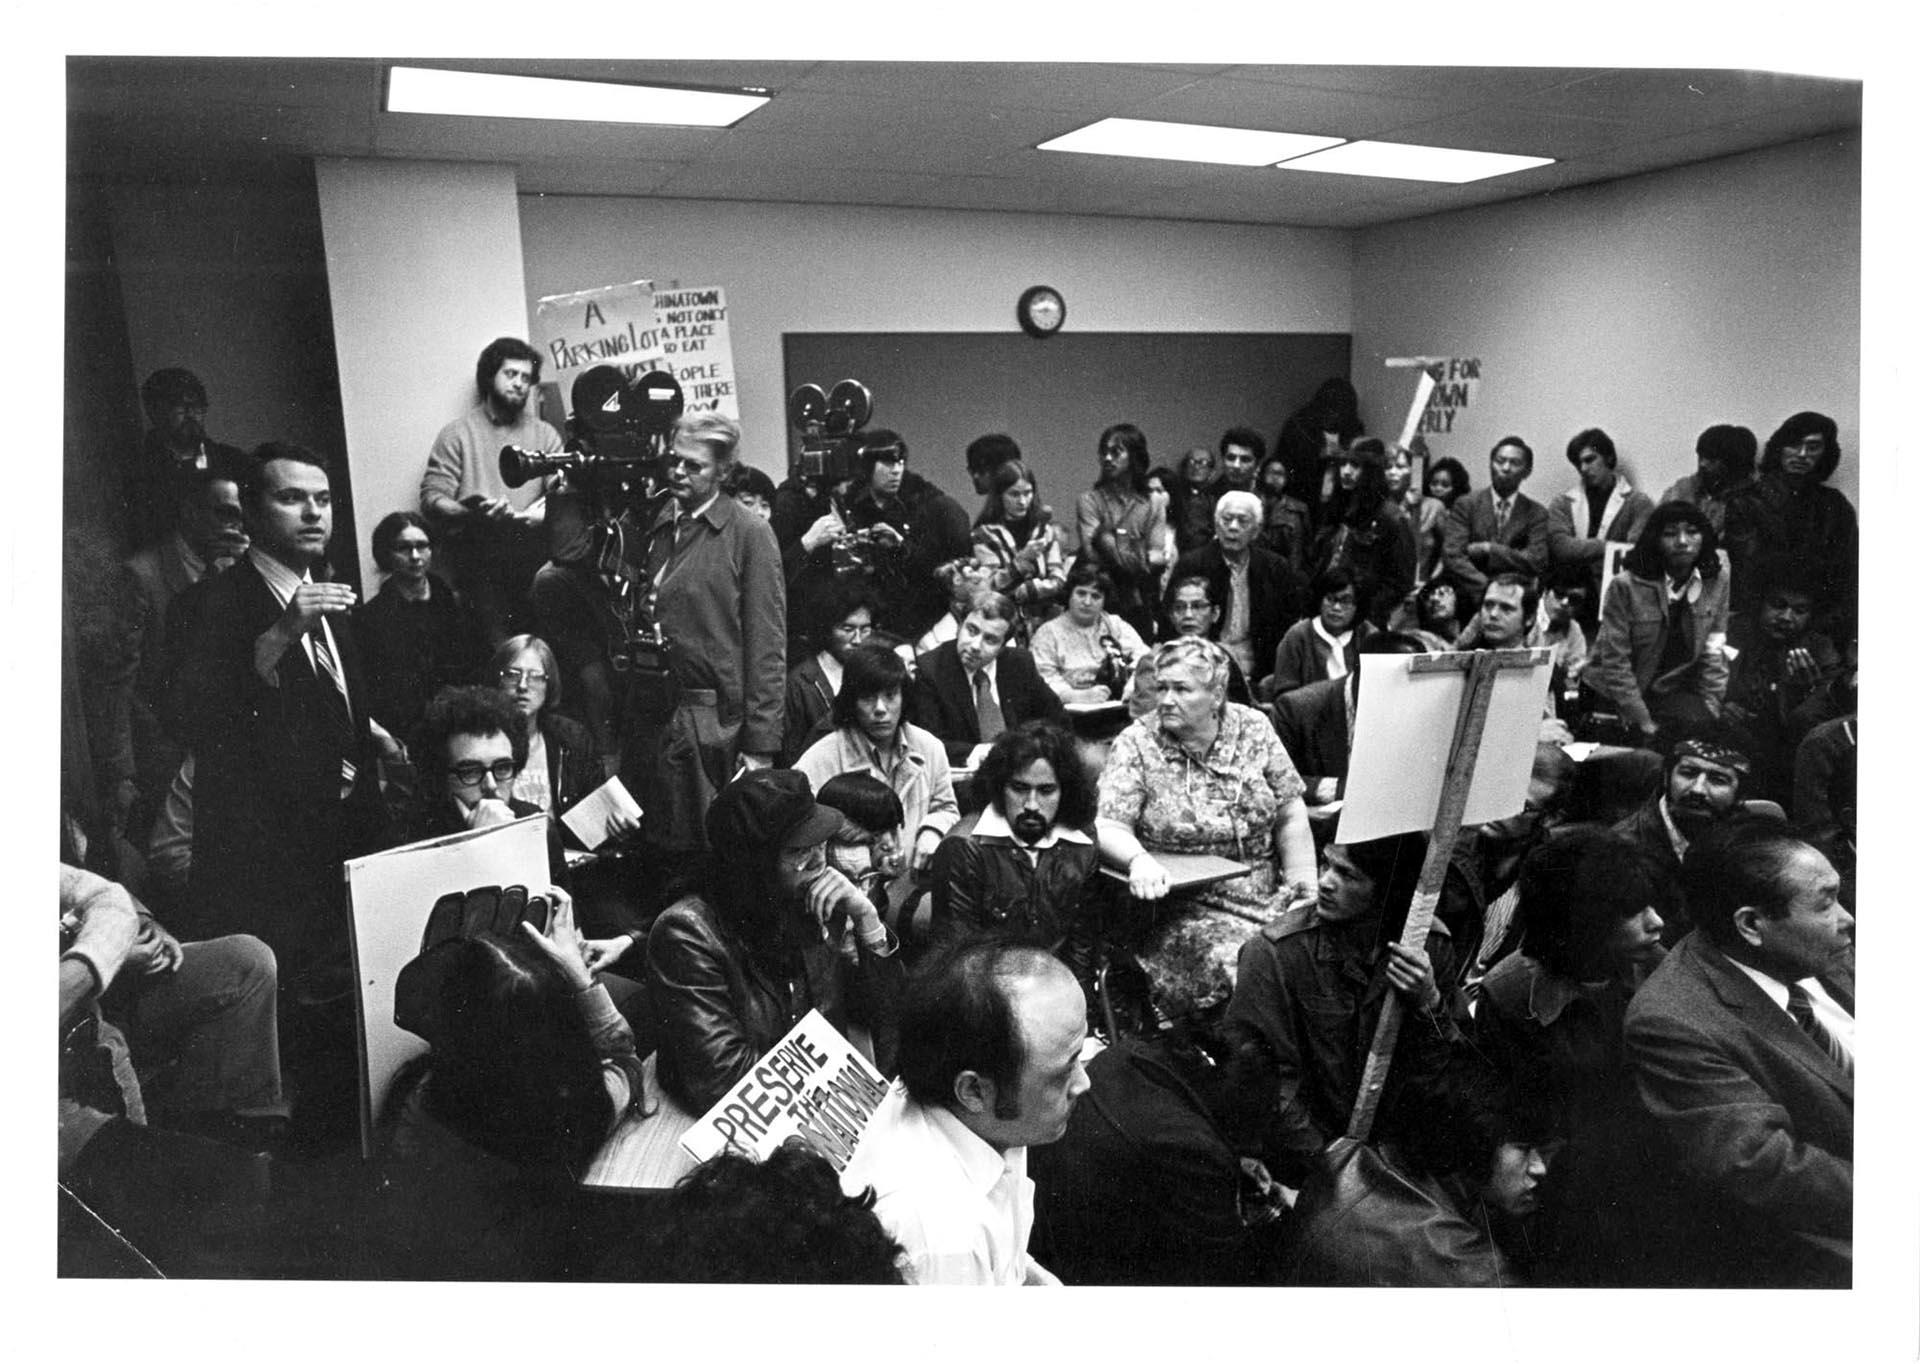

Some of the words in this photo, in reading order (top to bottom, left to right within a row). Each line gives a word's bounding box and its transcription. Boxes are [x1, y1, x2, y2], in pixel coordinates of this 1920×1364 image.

[654, 290, 719, 308] HINATOWN
[584, 299, 606, 329] A
[666, 310, 693, 324] NOT
[694, 306, 727, 323] ONLY
[660, 327, 671, 339] A
[675, 323, 715, 339] PLACE
[549, 337, 630, 370] PARKING
[627, 321, 660, 352] LOT
[681, 338, 707, 352] EAT
[1448, 358, 1482, 380] FOR
[691, 380, 735, 400] THERE
[712, 1032, 829, 1155] PRESERVE
[787, 1086, 832, 1125] THE
[797, 1053, 891, 1173] NATIONAL
